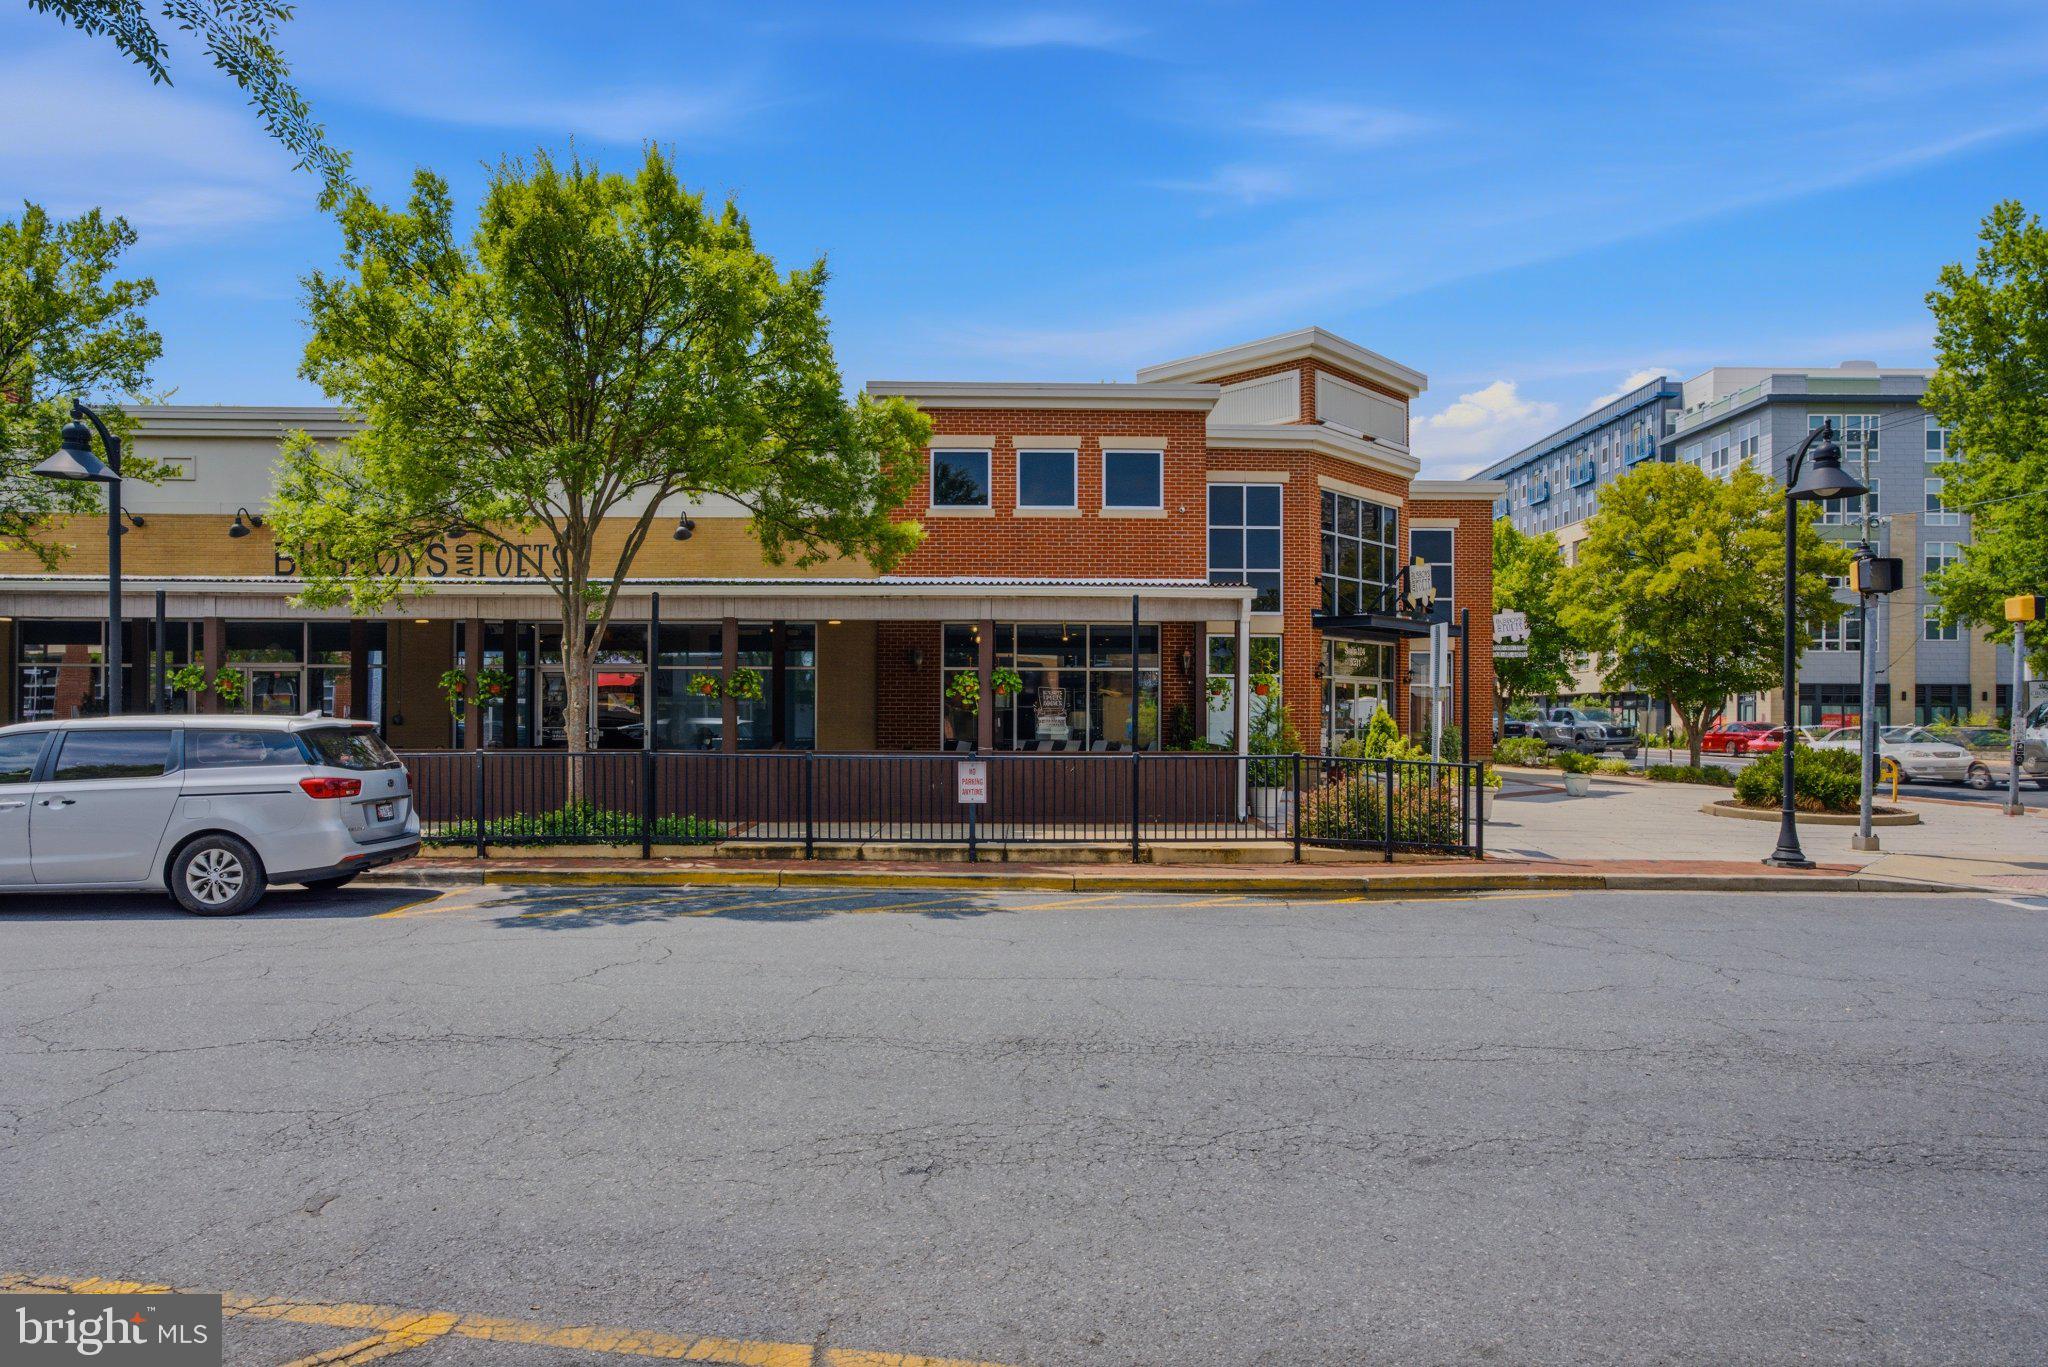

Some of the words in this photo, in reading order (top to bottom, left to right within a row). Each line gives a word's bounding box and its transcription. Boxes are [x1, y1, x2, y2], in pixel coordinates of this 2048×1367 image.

[455, 543, 474, 577] AND
[968, 768, 976, 776] NO
[961, 778, 983, 786] PARKING
[961, 788, 983, 796] ANYTIME
